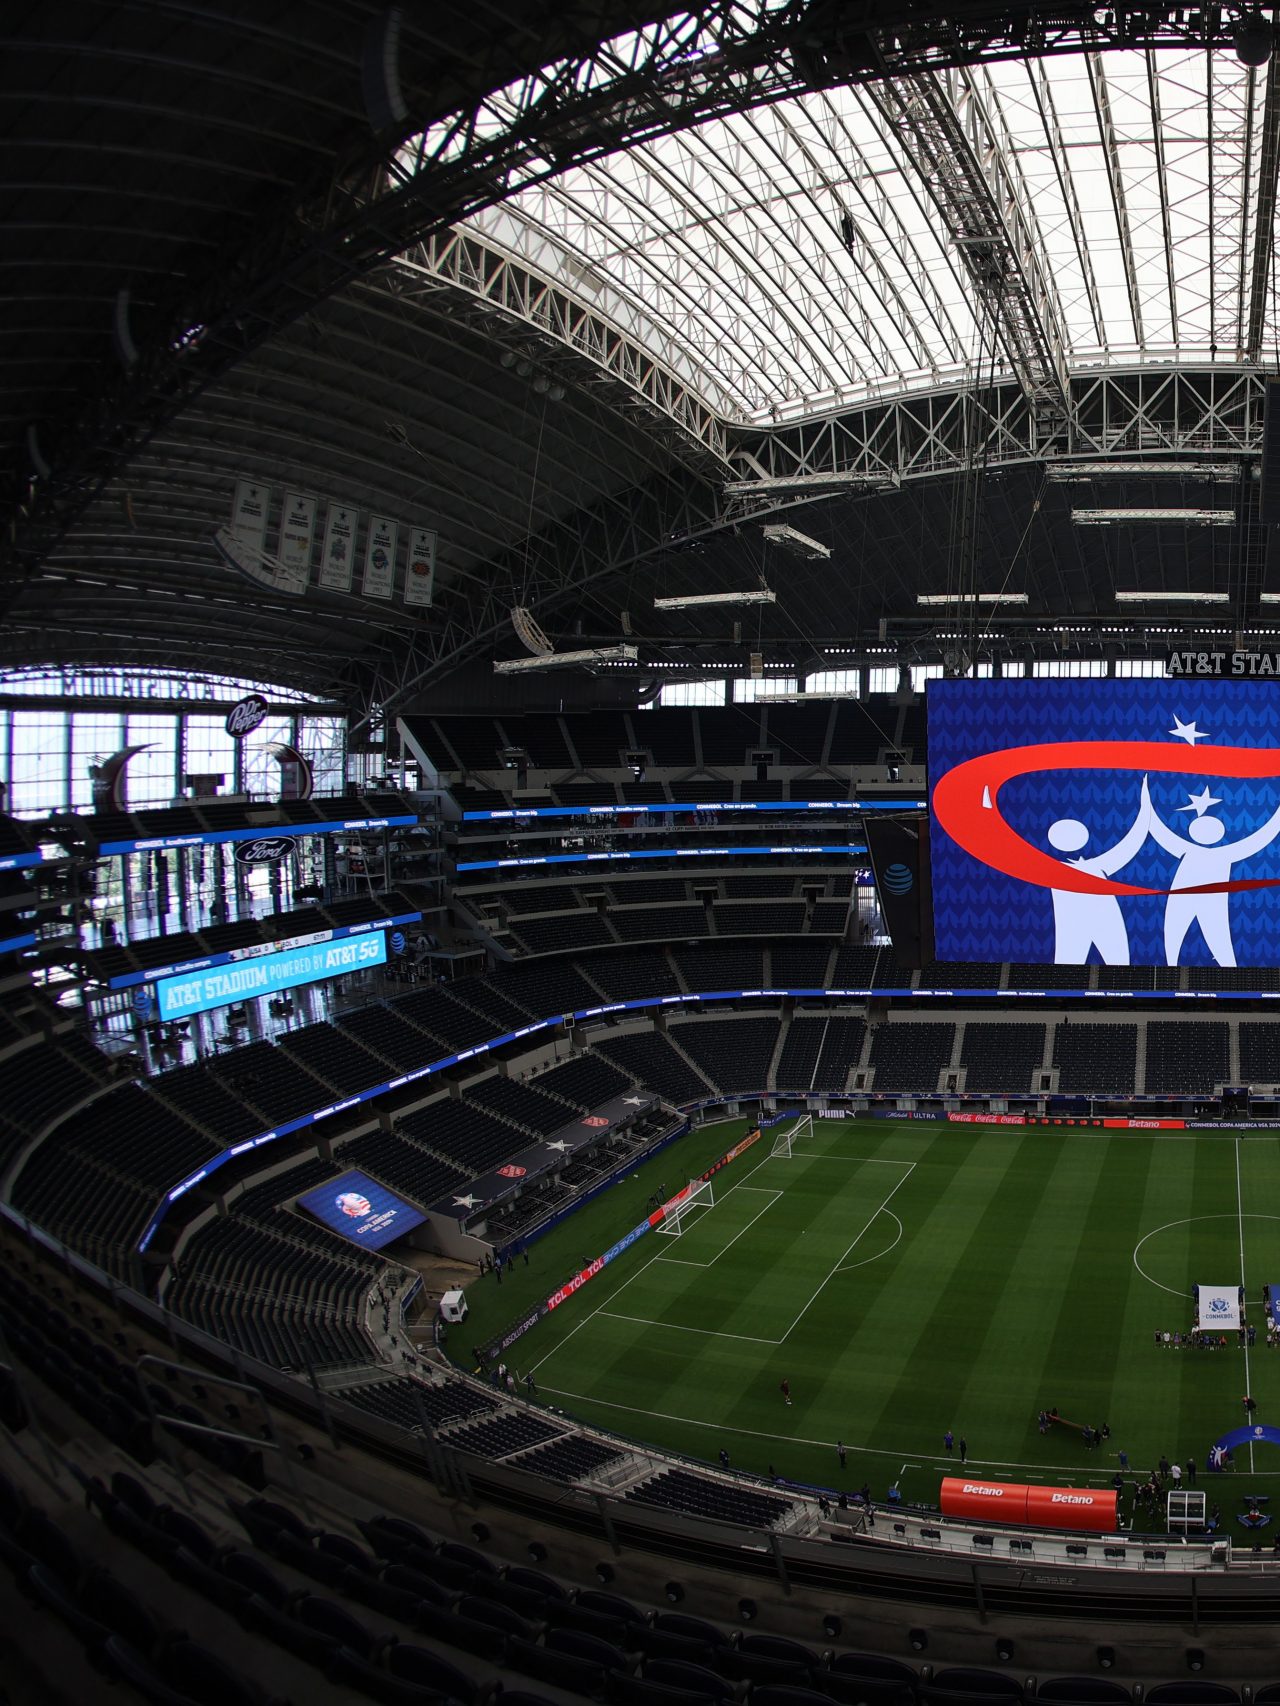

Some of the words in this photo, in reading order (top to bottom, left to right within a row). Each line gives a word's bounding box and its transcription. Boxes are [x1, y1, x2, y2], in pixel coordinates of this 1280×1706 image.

[1167, 652, 1225, 674] AT&T
[245, 700, 261, 716] Dr
[228, 703, 266, 732] Pepper
[245, 840, 286, 860] Ford
[166, 981, 203, 1010] AT&T
[205, 965, 268, 999] STADIUM
[270, 959, 313, 981] POWERED
[313, 955, 325, 971] BY
[325, 944, 357, 969] AT&T
[358, 939, 379, 960] 5G
[818, 1109, 845, 1119] PUMA
[913, 1111, 936, 1119] ULTRA
[1128, 1119, 1160, 1128] Betano
[588, 1259, 604, 1276] TCL
[569, 1275, 587, 1293] TCL
[548, 1290, 567, 1310] TCL
[502, 1325, 526, 1350] ABSOLUT
[524, 1312, 540, 1332] SPORT
[962, 1484, 1004, 1497] Betano
[1051, 1493, 1093, 1505] Betano
